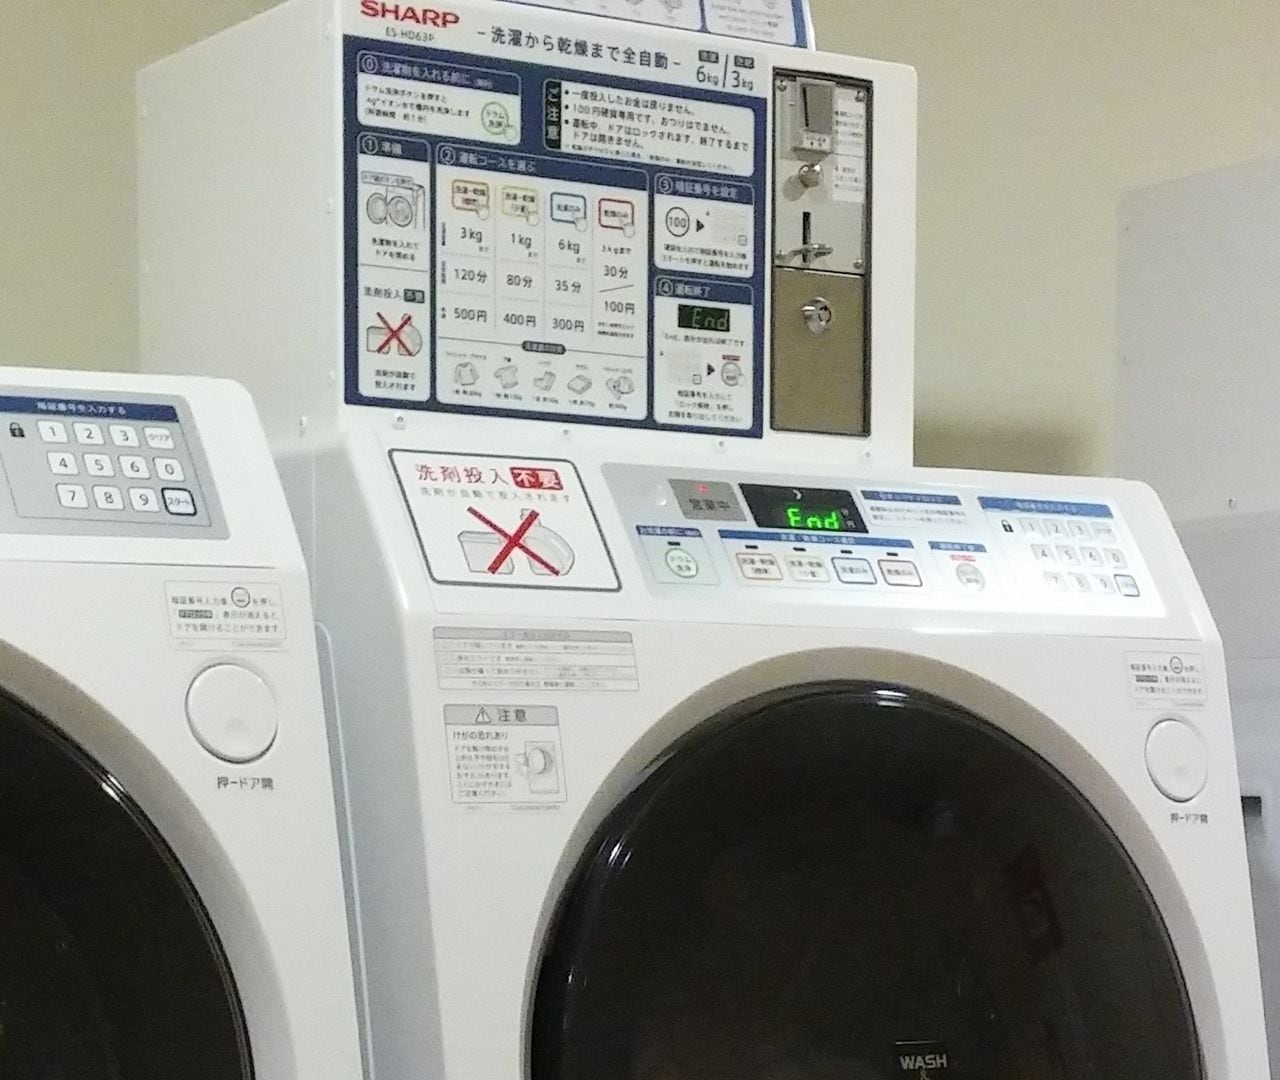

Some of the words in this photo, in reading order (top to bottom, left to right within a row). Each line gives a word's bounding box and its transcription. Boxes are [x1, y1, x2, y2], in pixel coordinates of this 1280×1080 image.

[360, 1, 460, 28] SHARP
[669, 216, 687, 228] 100
[454, 268, 487, 283] 120分
[605, 301, 635, 315] 100円
[454, 308, 487, 323] 500円
[503, 313, 537, 328] 400円
[692, 307, 728, 330] End
[552, 318, 584, 333] 300円
[49, 427, 56, 437] 1
[85, 428, 94, 439] 2
[121, 430, 129, 442] 3
[59, 457, 68, 469] 4
[95, 459, 104, 471] 5
[130, 461, 140, 472] 6
[165, 463, 174, 475] 0
[416, 464, 509, 485] 洗剤投入
[67, 490, 76, 502] 7
[104, 492, 114, 504] 8
[139, 494, 149, 506] 9
[786, 505, 842, 530] End
[498, 708, 527, 723] 注意
[900, 1054, 947, 1070] WASH
